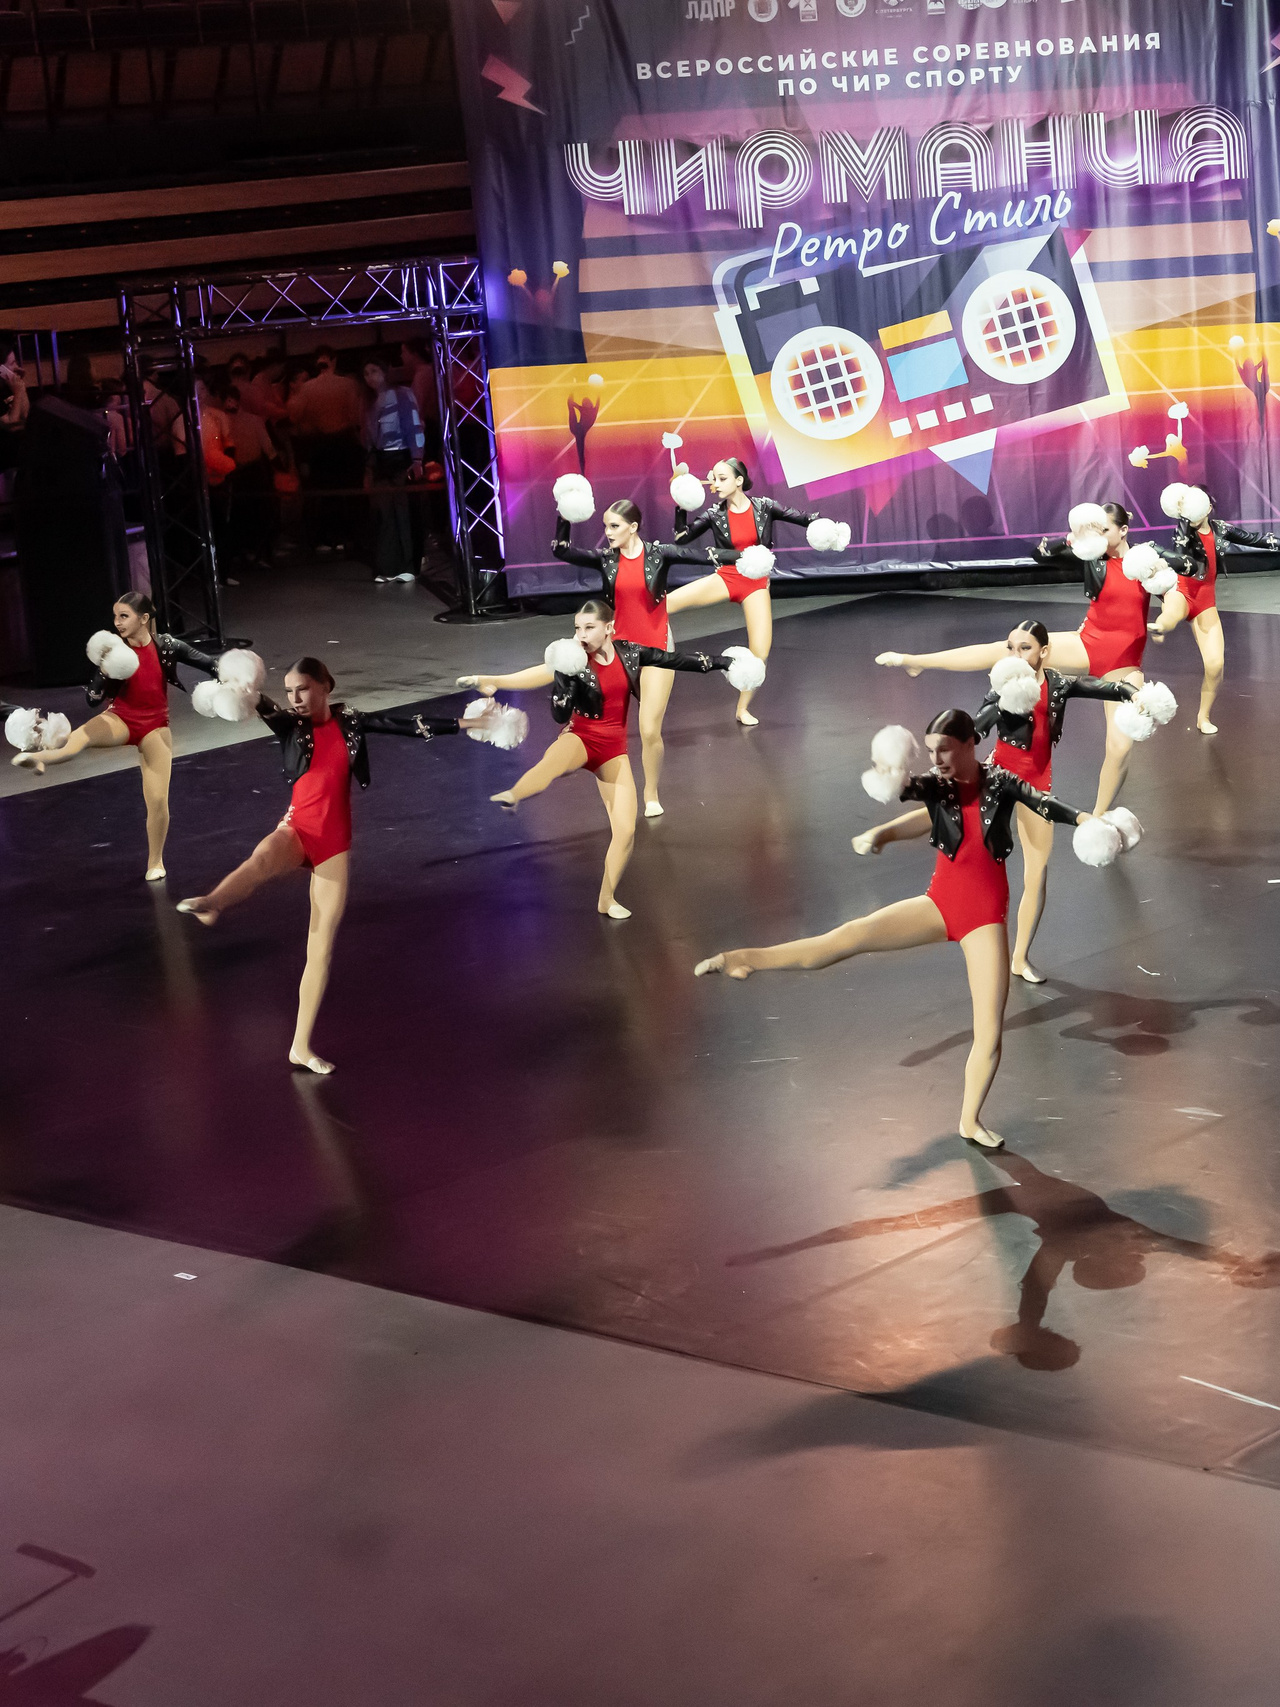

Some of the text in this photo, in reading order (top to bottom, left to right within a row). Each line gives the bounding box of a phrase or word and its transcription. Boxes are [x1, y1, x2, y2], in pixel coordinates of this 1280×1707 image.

[686, 0, 736, 21] ЛДПР
[636, 32, 1161, 80] ВСЕРОССИЙСКИЕ СОРЕВНОВАНИЯ
[778, 65, 1022, 96] ПО ЧИР СПОРТУ
[769, 190, 1072, 278] Ретро Стиль
